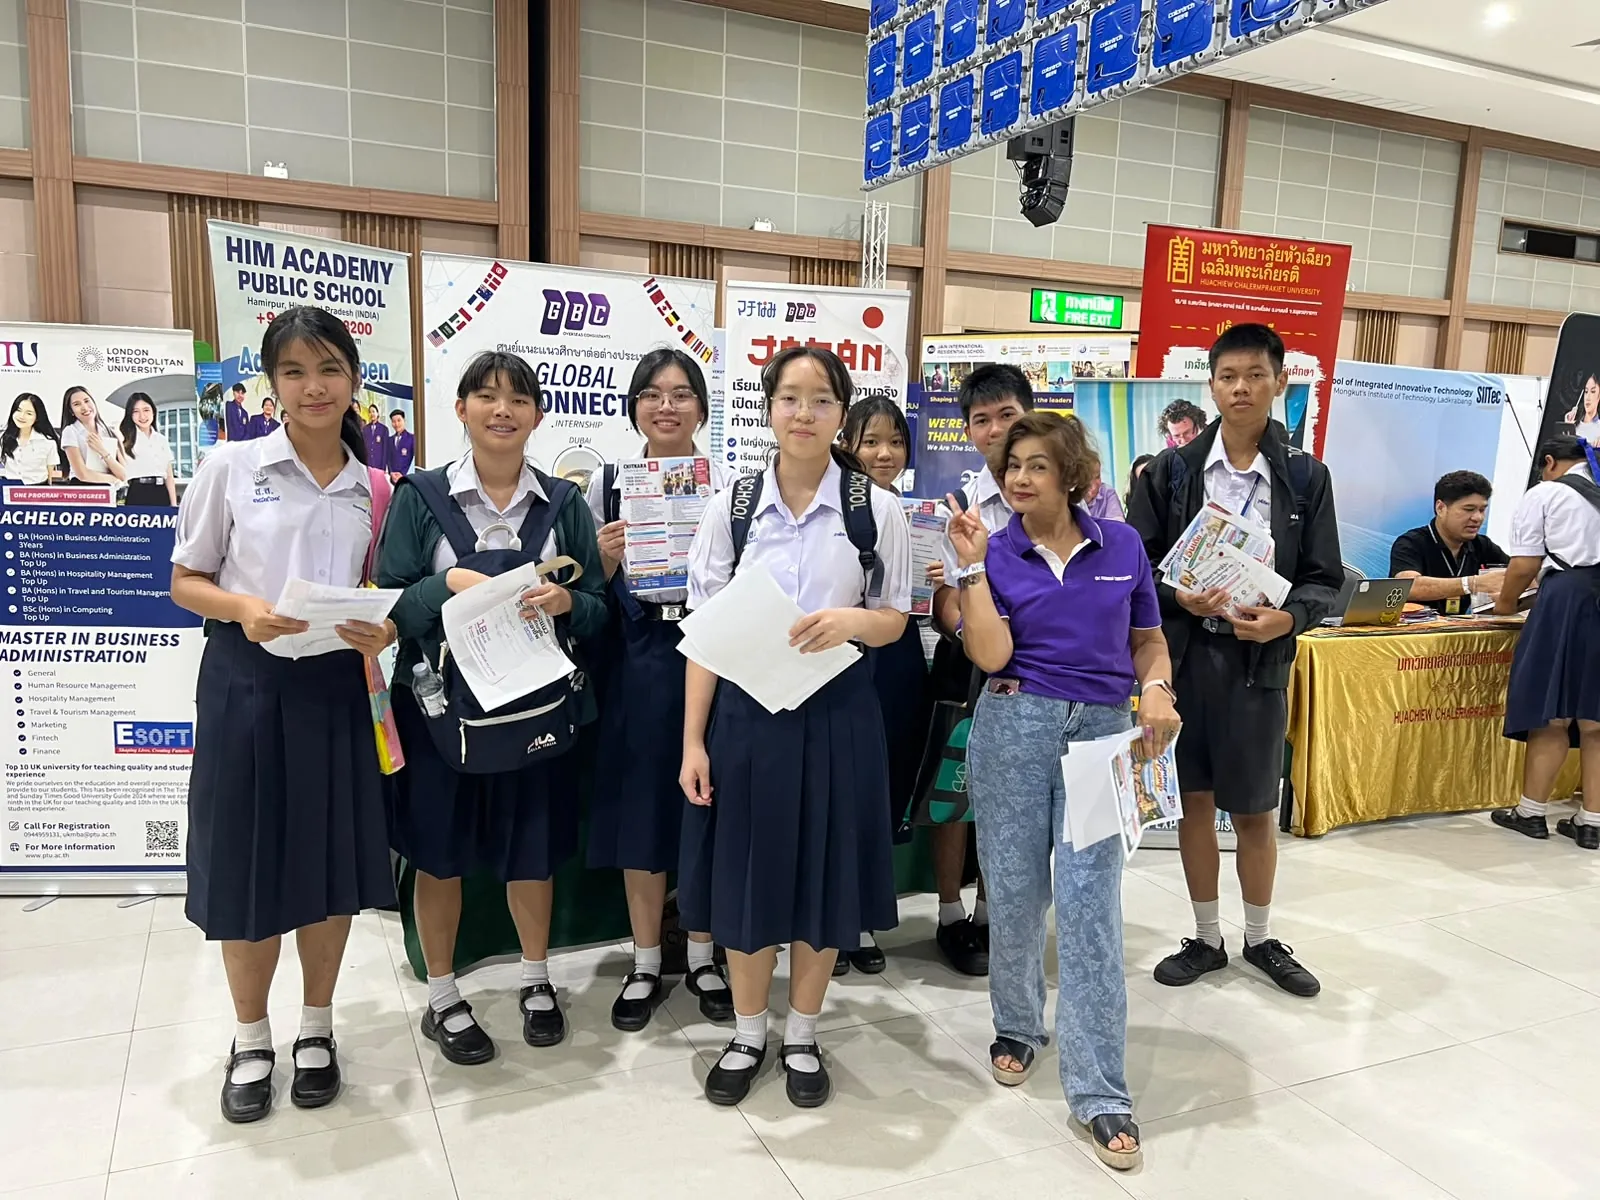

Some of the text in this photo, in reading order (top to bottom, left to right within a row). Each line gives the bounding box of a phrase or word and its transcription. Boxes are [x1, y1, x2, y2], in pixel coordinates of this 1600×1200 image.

[1201, 239, 1332, 267] มหาวิทยาลัยหัวเฉียว
[226, 236, 394, 285] HIM ACADEMY
[1200, 257, 1300, 284] เฉลิมพระเกียรติ
[238, 270, 386, 308] PUBLIC SCHOOL
[1200, 278, 1233, 288] HUACHIEW
[1287, 286, 1320, 296] UNIVERSITY
[247, 296, 287, 310] Hamirpur,
[325, 306, 354, 317] Pradesh
[355, 310, 380, 320] (INDIA)
[543, 294, 609, 330] GBC
[1065, 312, 1112, 326] FIRE EXIT
[106, 348, 148, 356] LONDON
[106, 356, 184, 367] METROPOLITAN
[108, 366, 166, 374] UNIVERSITY
[536, 362, 617, 389] GLOBAL
[1345, 378, 1353, 386] of
[1354, 379, 1394, 390] Integrated
[1395, 381, 1432, 394] Innovative
[1433, 386, 1474, 398] Technology
[930, 396, 952, 404] Shaping
[1368, 390, 1393, 399] Institute
[1402, 393, 1436, 404] Technology
[541, 390, 628, 416] ONNECT
[556, 420, 603, 428] INTERNSHIP
[569, 436, 592, 444] DUBAI
[928, 432, 968, 442] THAN A
[849, 472, 869, 512] SCHOOL
[732, 478, 755, 522] SCHOOL
[0, 510, 85, 526] ACHELOR
[30, 533, 54, 542] (Hons)
[64, 534, 97, 542] Business
[98, 535, 150, 543] Administration
[32, 551, 56, 560] (Hons)
[66, 552, 98, 560] Business
[100, 553, 150, 561] Administration
[20, 560, 46, 568] Top Up
[32, 570, 57, 578] (Hons)
[66, 570, 106, 578] Hospitality
[108, 572, 152, 580] Management
[21, 578, 48, 586] Top Up
[34, 587, 58, 596] (Hons)
[90, 588, 105, 596] and
[106, 588, 134, 596] Tourism
[38, 606, 62, 614] (Hons)
[72, 606, 113, 615] Computing
[23, 614, 50, 622] Top Up
[0, 632, 180, 647] MASTER IN BUSINESS
[0, 649, 147, 664] ADMINISTRATION
[90, 682, 136, 690] Management
[28, 695, 68, 703] Hospitality
[1394, 708, 1432, 724] HUACHIEW
[31, 722, 68, 730] Marketing
[32, 734, 58, 742] Fintech
[528, 732, 556, 754] FILA
[94, 764, 126, 772] teaching
[127, 764, 152, 772] quality
[24, 822, 110, 831] Call For Registration
